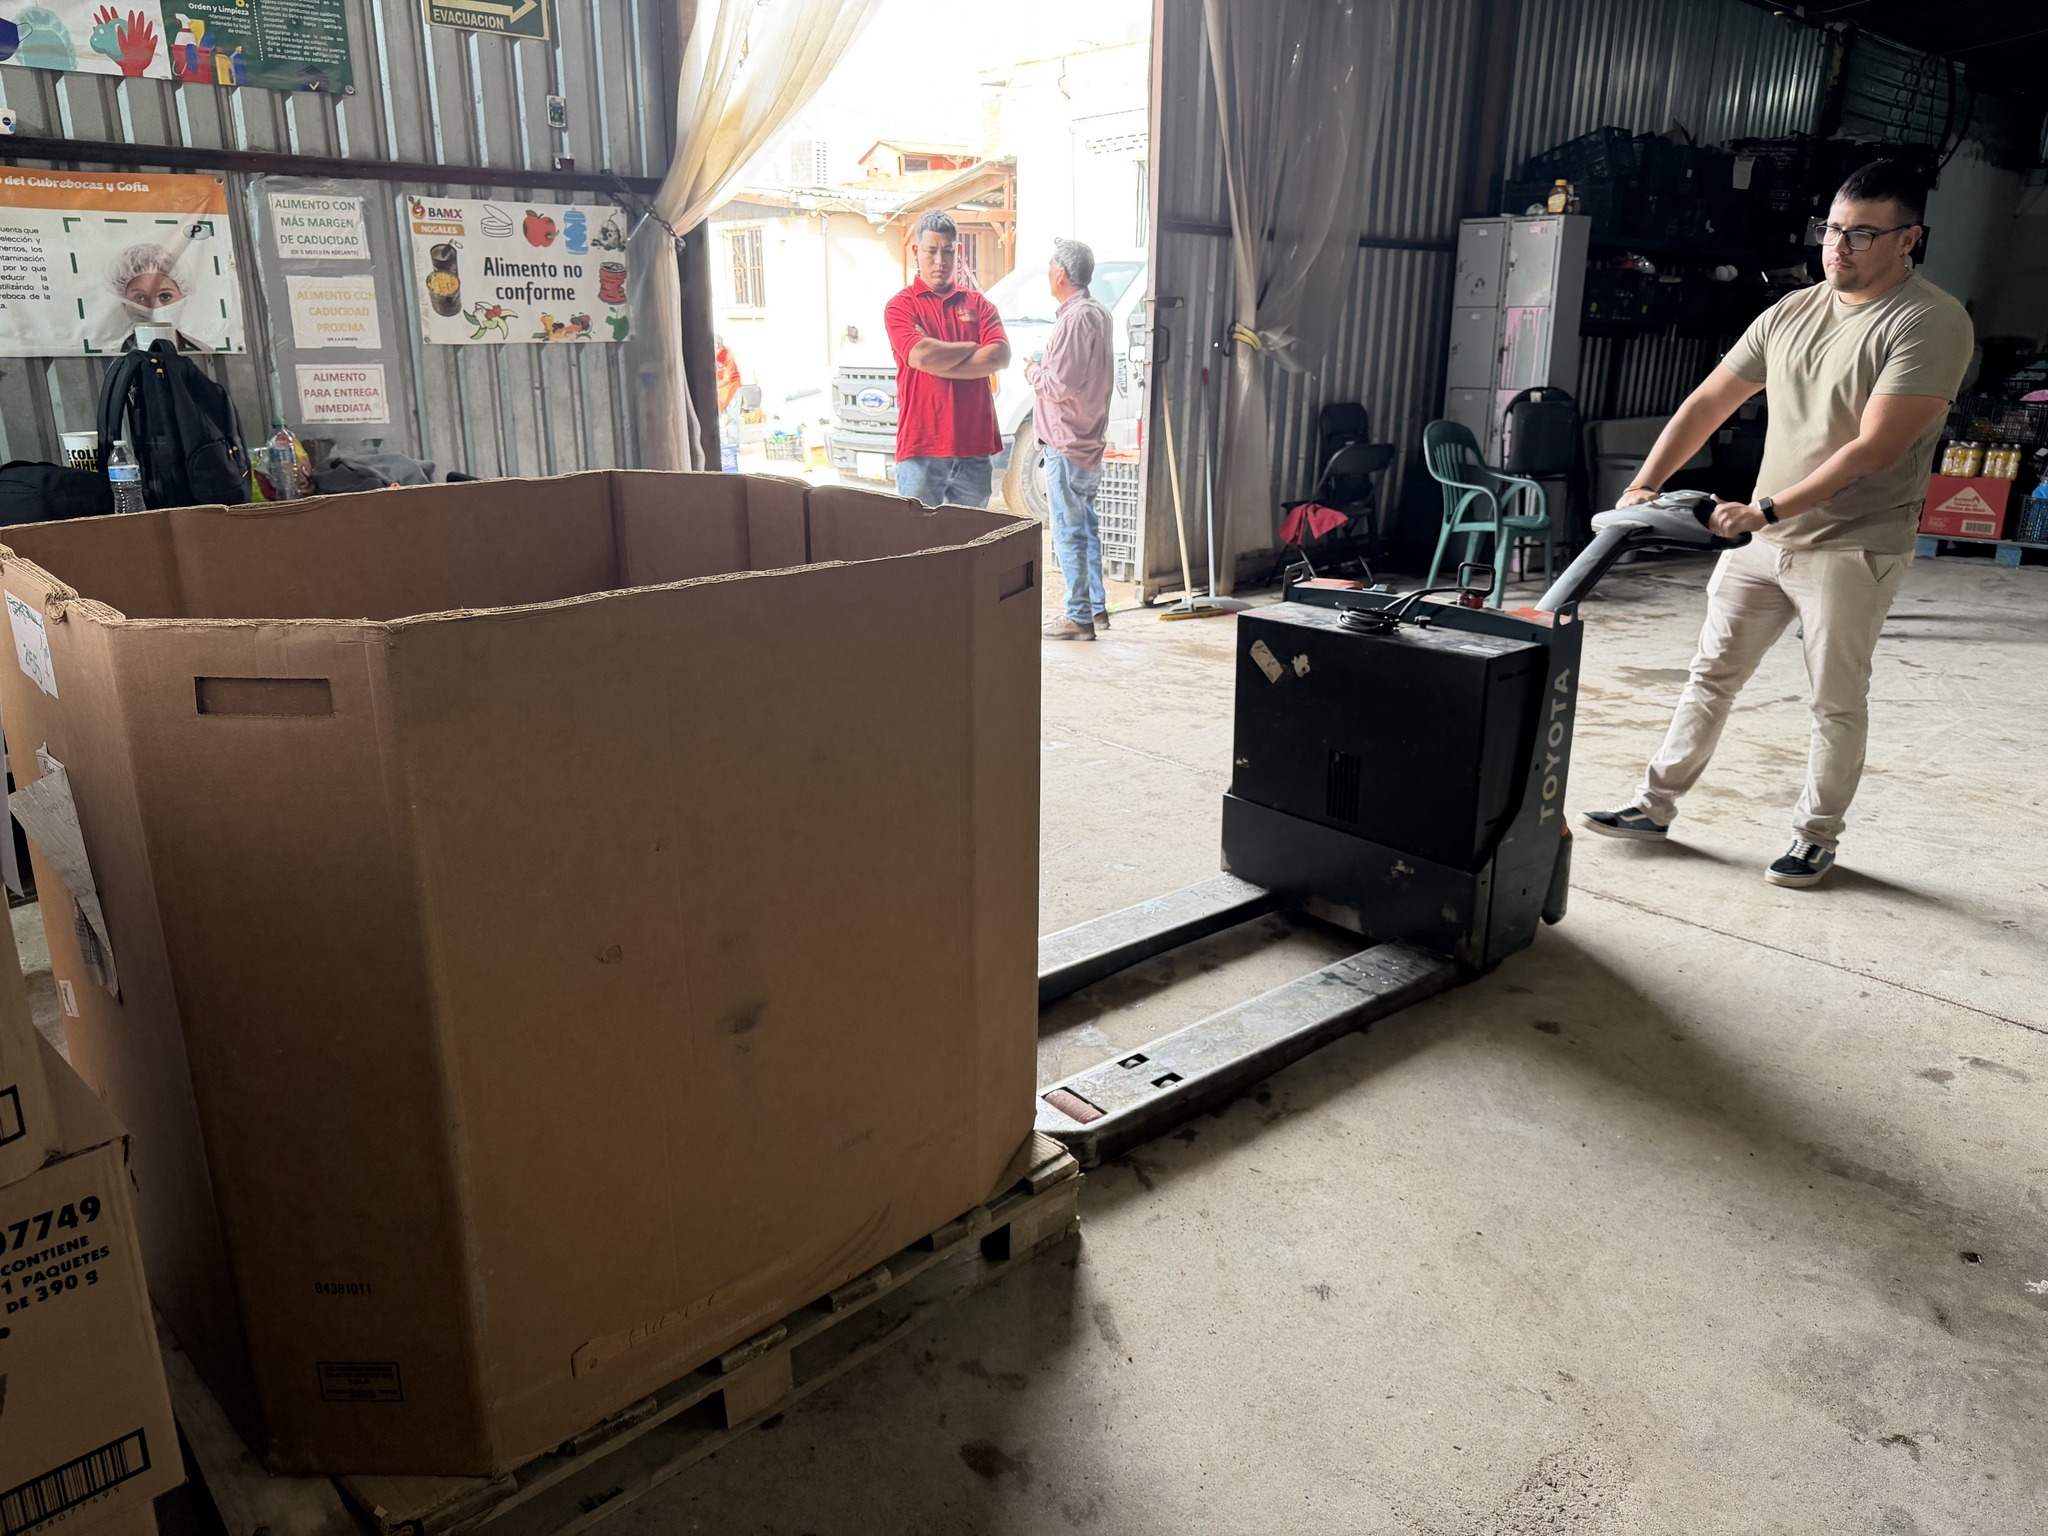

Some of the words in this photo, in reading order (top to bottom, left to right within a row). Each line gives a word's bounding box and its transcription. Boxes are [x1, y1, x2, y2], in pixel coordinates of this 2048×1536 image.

[189, 2, 211, 11] Orden
[218, 5, 250, 16] Limpieza
[232, 16, 246, 24] limpio
[434, 9, 504, 30] EVACUACION
[5, 176, 25, 186] del
[28, 177, 104, 190] Cubrebocas
[106, 182, 115, 193] y
[117, 182, 149, 193] Cofia
[275, 200, 330, 210] ALIMENTO
[333, 202, 356, 211] CON
[429, 208, 463, 219] BAMX
[281, 215, 305, 227] MÁS
[308, 218, 354, 228] MARGEN
[421, 225, 458, 234] NOGALES
[281, 235, 294, 244] DE
[297, 236, 359, 246] CADUCIDAD
[484, 257, 557, 278] Alimento
[564, 265, 583, 278] no
[297, 291, 351, 300] ALIMENTO
[354, 291, 377, 300] CON
[496, 282, 576, 305] conforme
[309, 307, 369, 316] CADUCIDAD
[317, 323, 365, 332] PROXIMA
[313, 373, 367, 382] ALIMENTO
[304, 389, 331, 398] PARA
[334, 388, 380, 397] ENTREGA
[315, 404, 372, 413] INMEDIATA
[1538, 668, 1570, 826] TOYOTA
[1, 1235, 89, 1277] CONTIENE
[22, 1246, 110, 1288] PAQUETES
[6, 1296, 29, 1314] DE
[35, 1274, 78, 1302] 390
[85, 1270, 99, 1286] g
